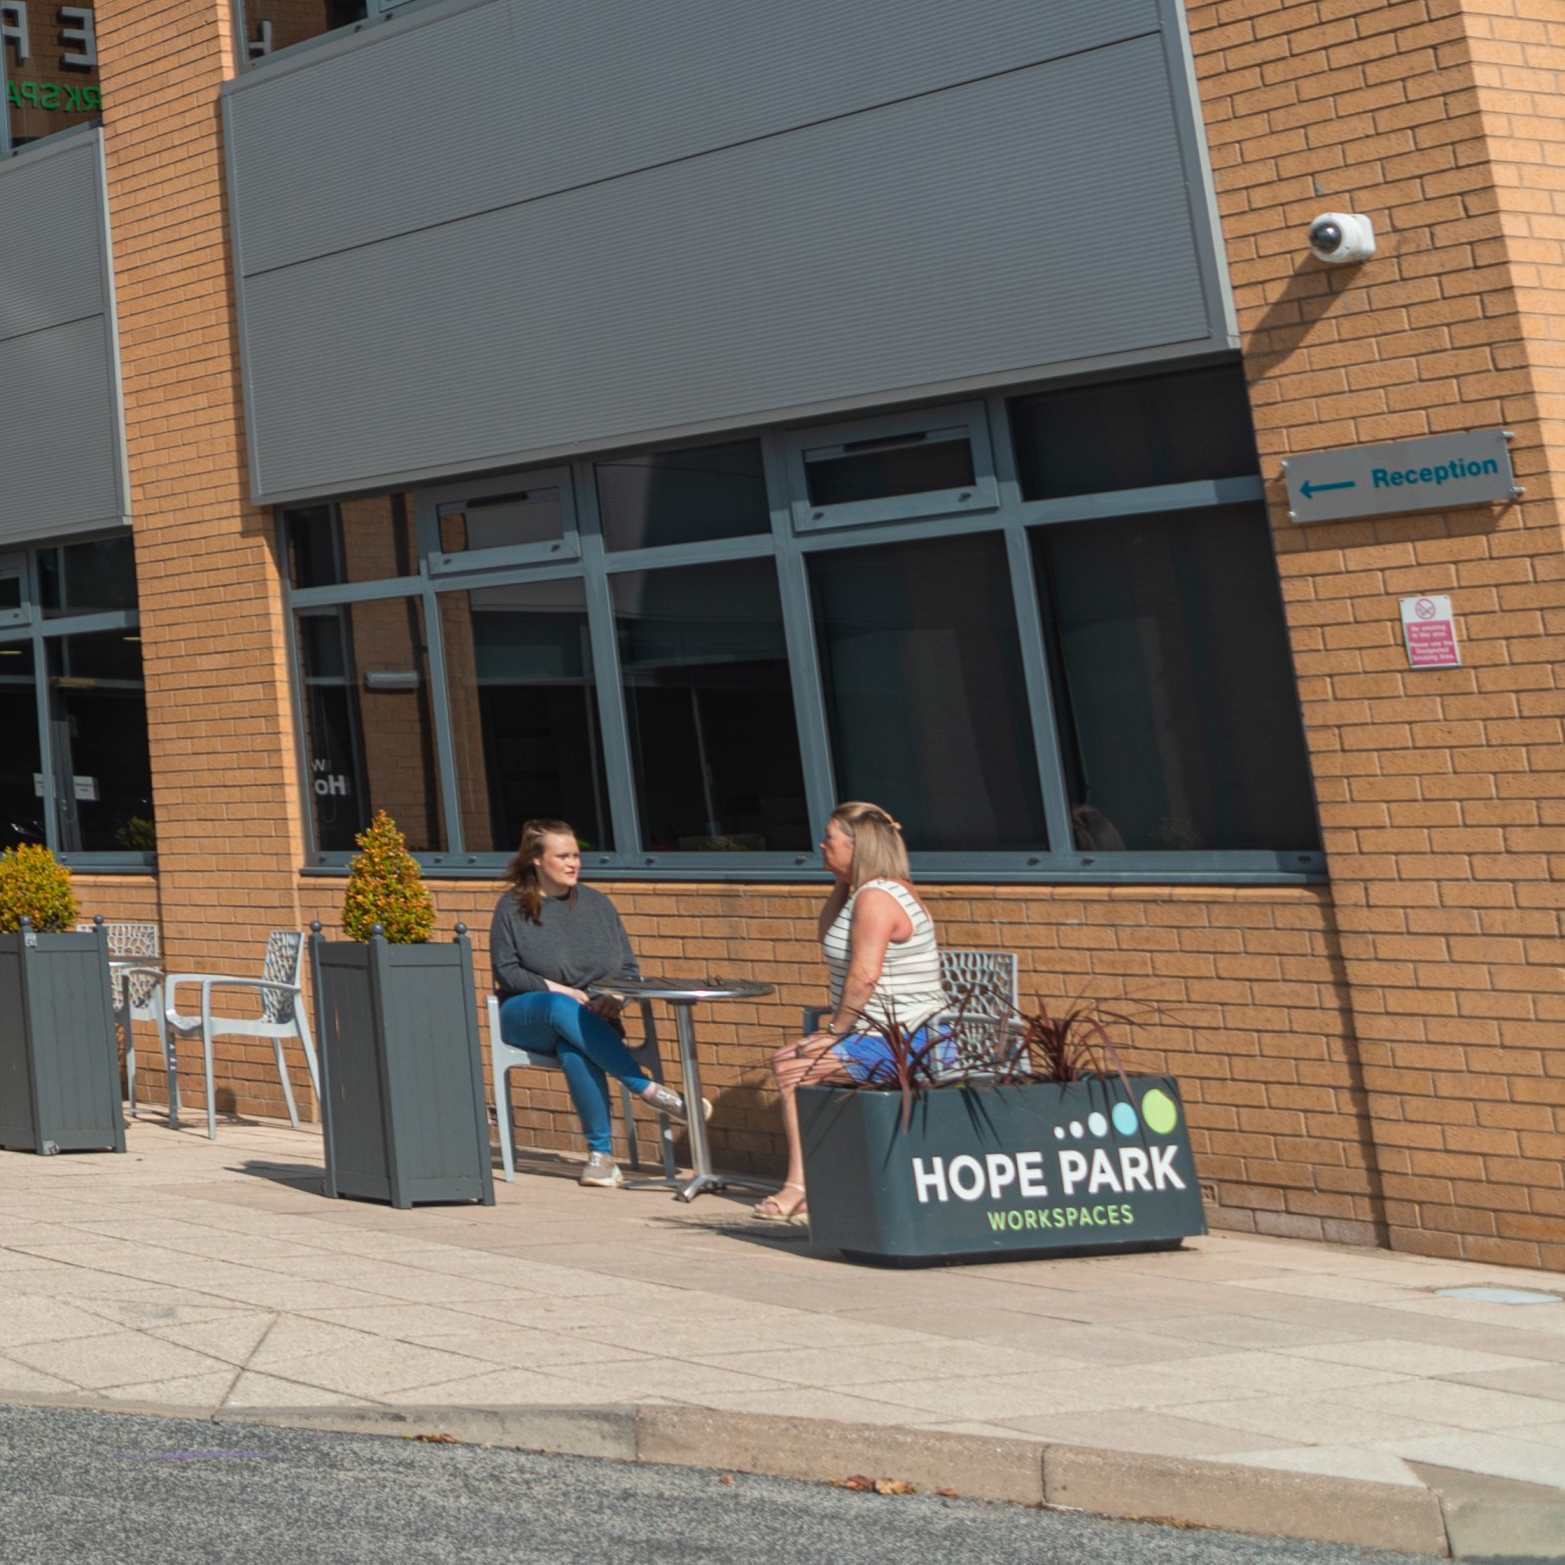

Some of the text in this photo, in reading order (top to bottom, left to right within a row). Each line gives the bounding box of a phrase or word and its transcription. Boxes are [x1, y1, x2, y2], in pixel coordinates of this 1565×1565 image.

[1371, 458, 1498, 488] Reception
[911, 1145, 1187, 1203] HOPE PARK
[987, 1204, 1134, 1231] WORKSPACES
